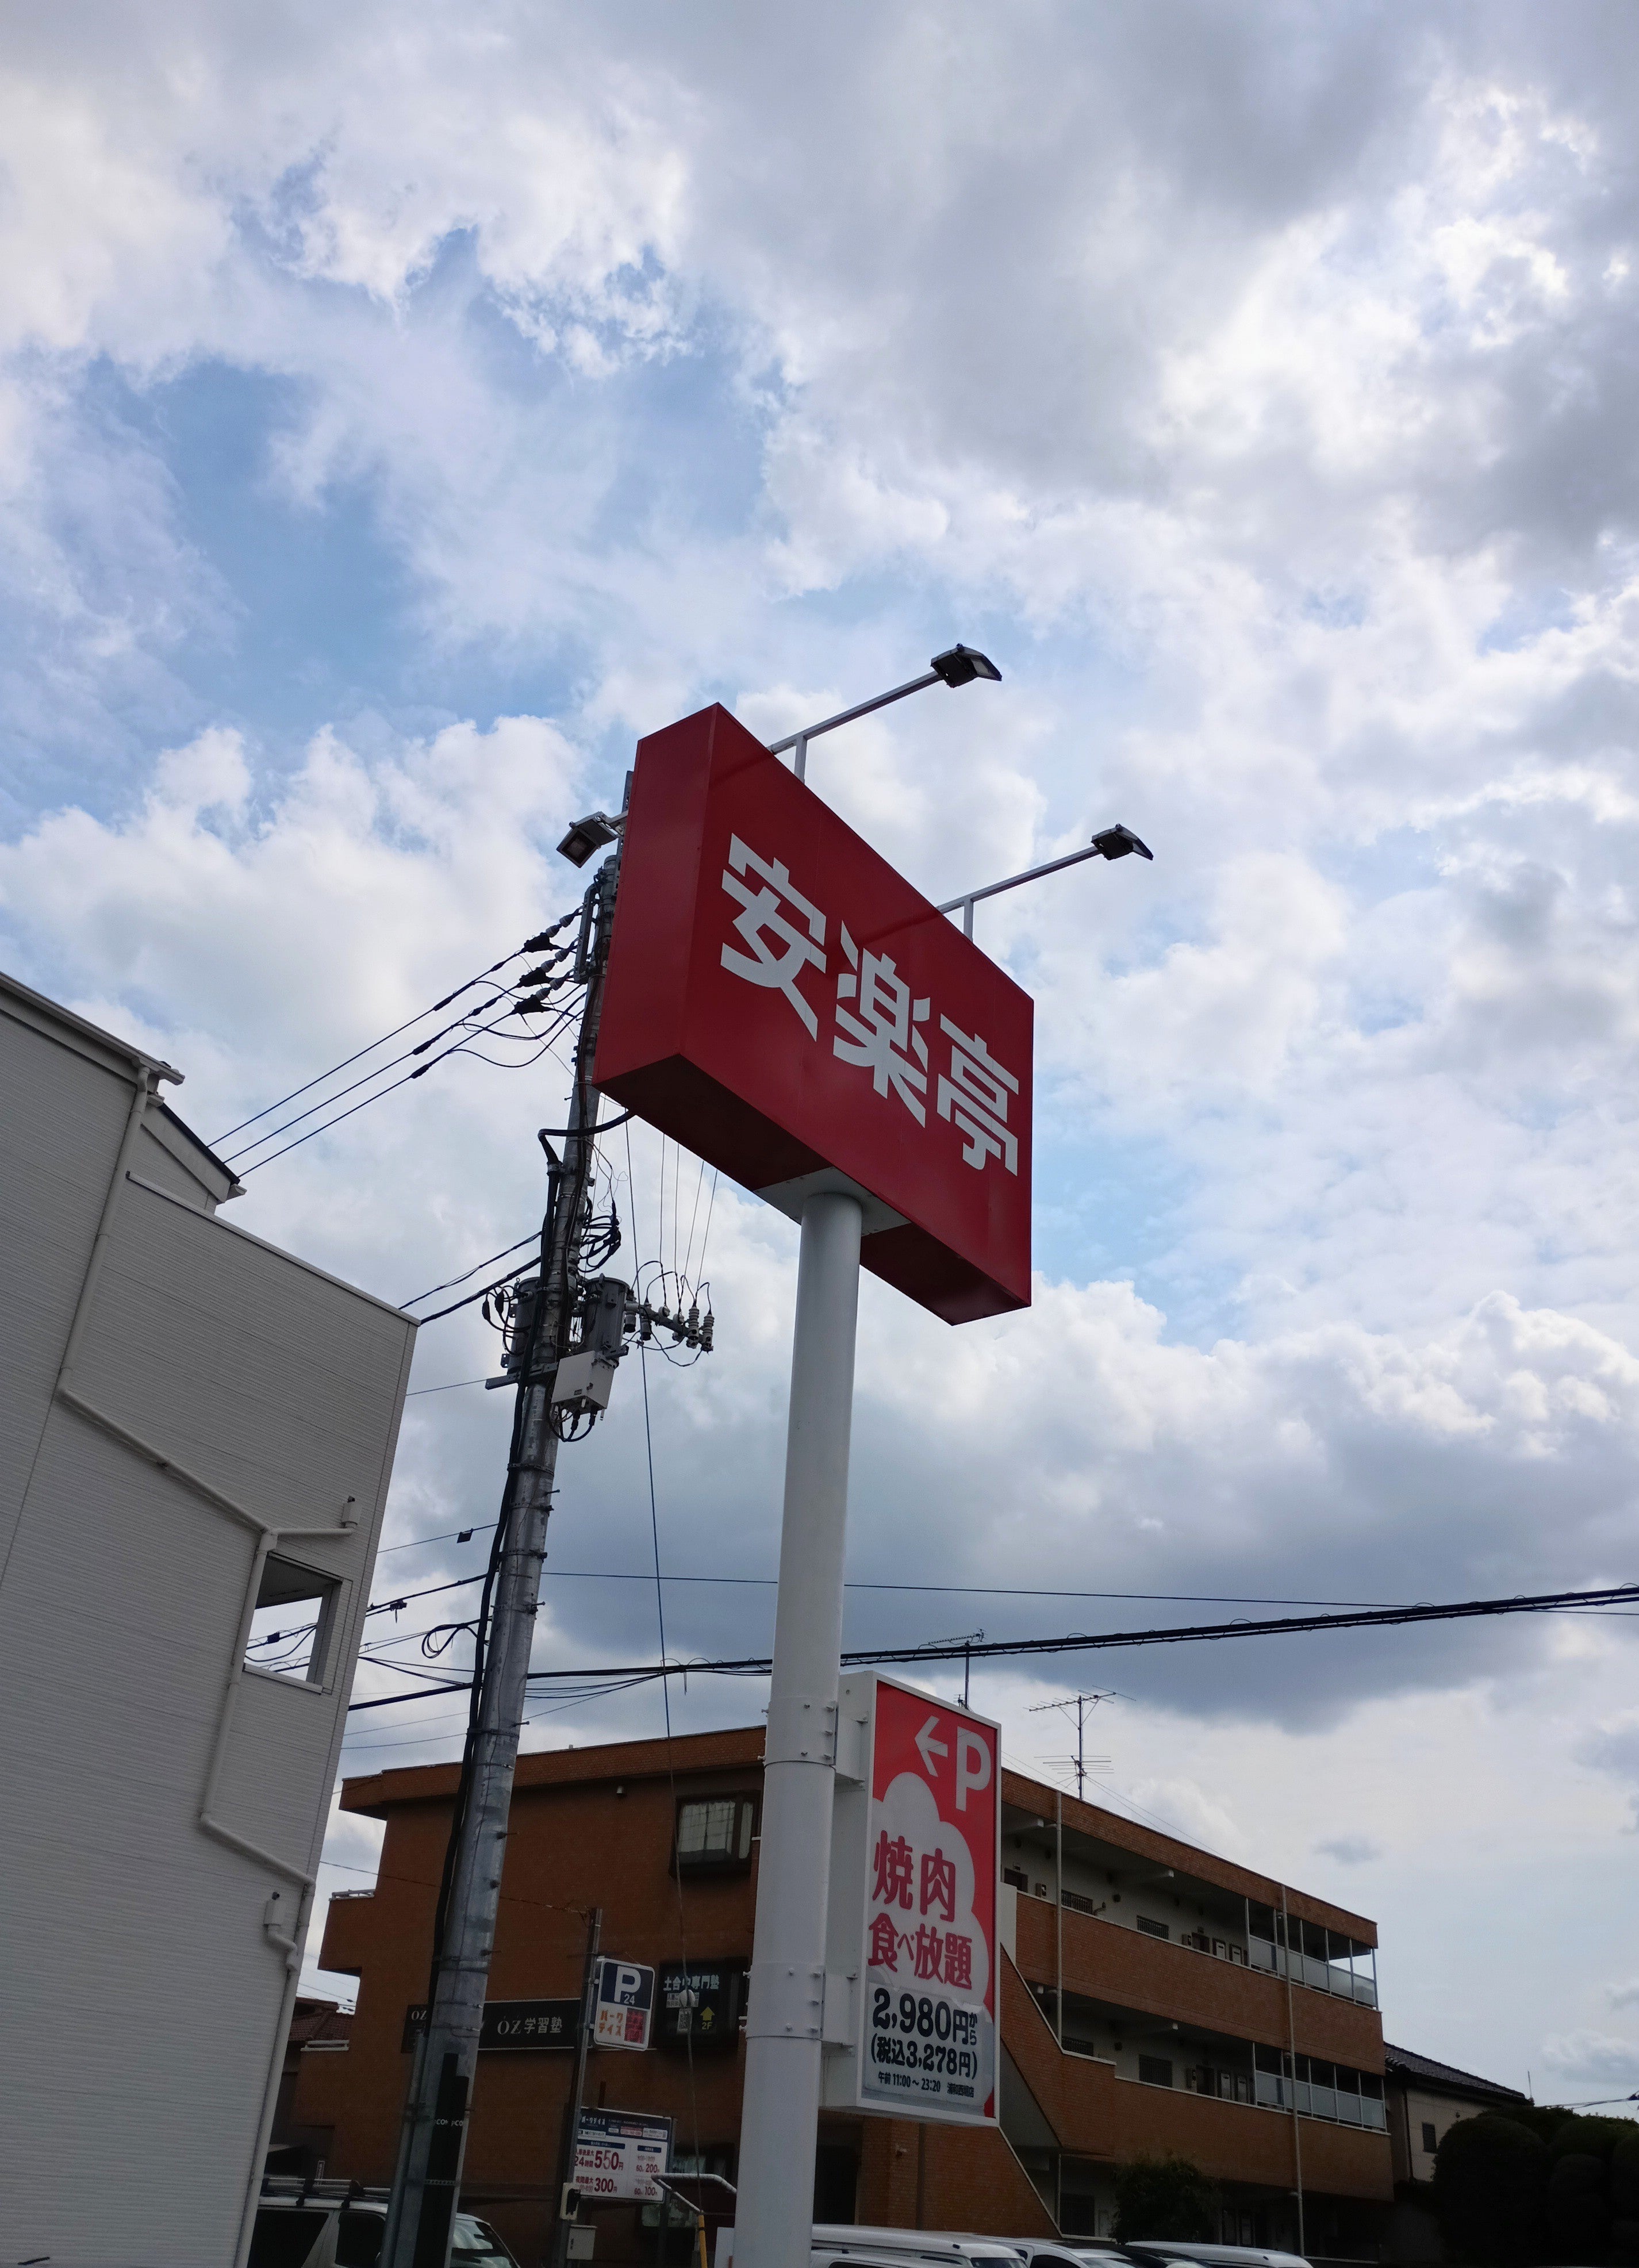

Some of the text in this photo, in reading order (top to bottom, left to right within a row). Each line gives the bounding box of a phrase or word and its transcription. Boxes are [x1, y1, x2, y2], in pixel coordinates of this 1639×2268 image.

[720, 832, 1018, 1176] 安楽亭
[955, 1726, 991, 1812] P
[873, 1830, 955, 1922] 焼肉
[868, 1913, 972, 1990] 食べ放題
[614, 1966, 641, 2002] P
[624, 1993, 635, 2005] 24
[701, 2022, 713, 2030] 2F
[872, 2033, 977, 2079] (税込3,278円)
[594, 2150, 624, 2170] 550円
[594, 2177, 617, 2193] 300円
